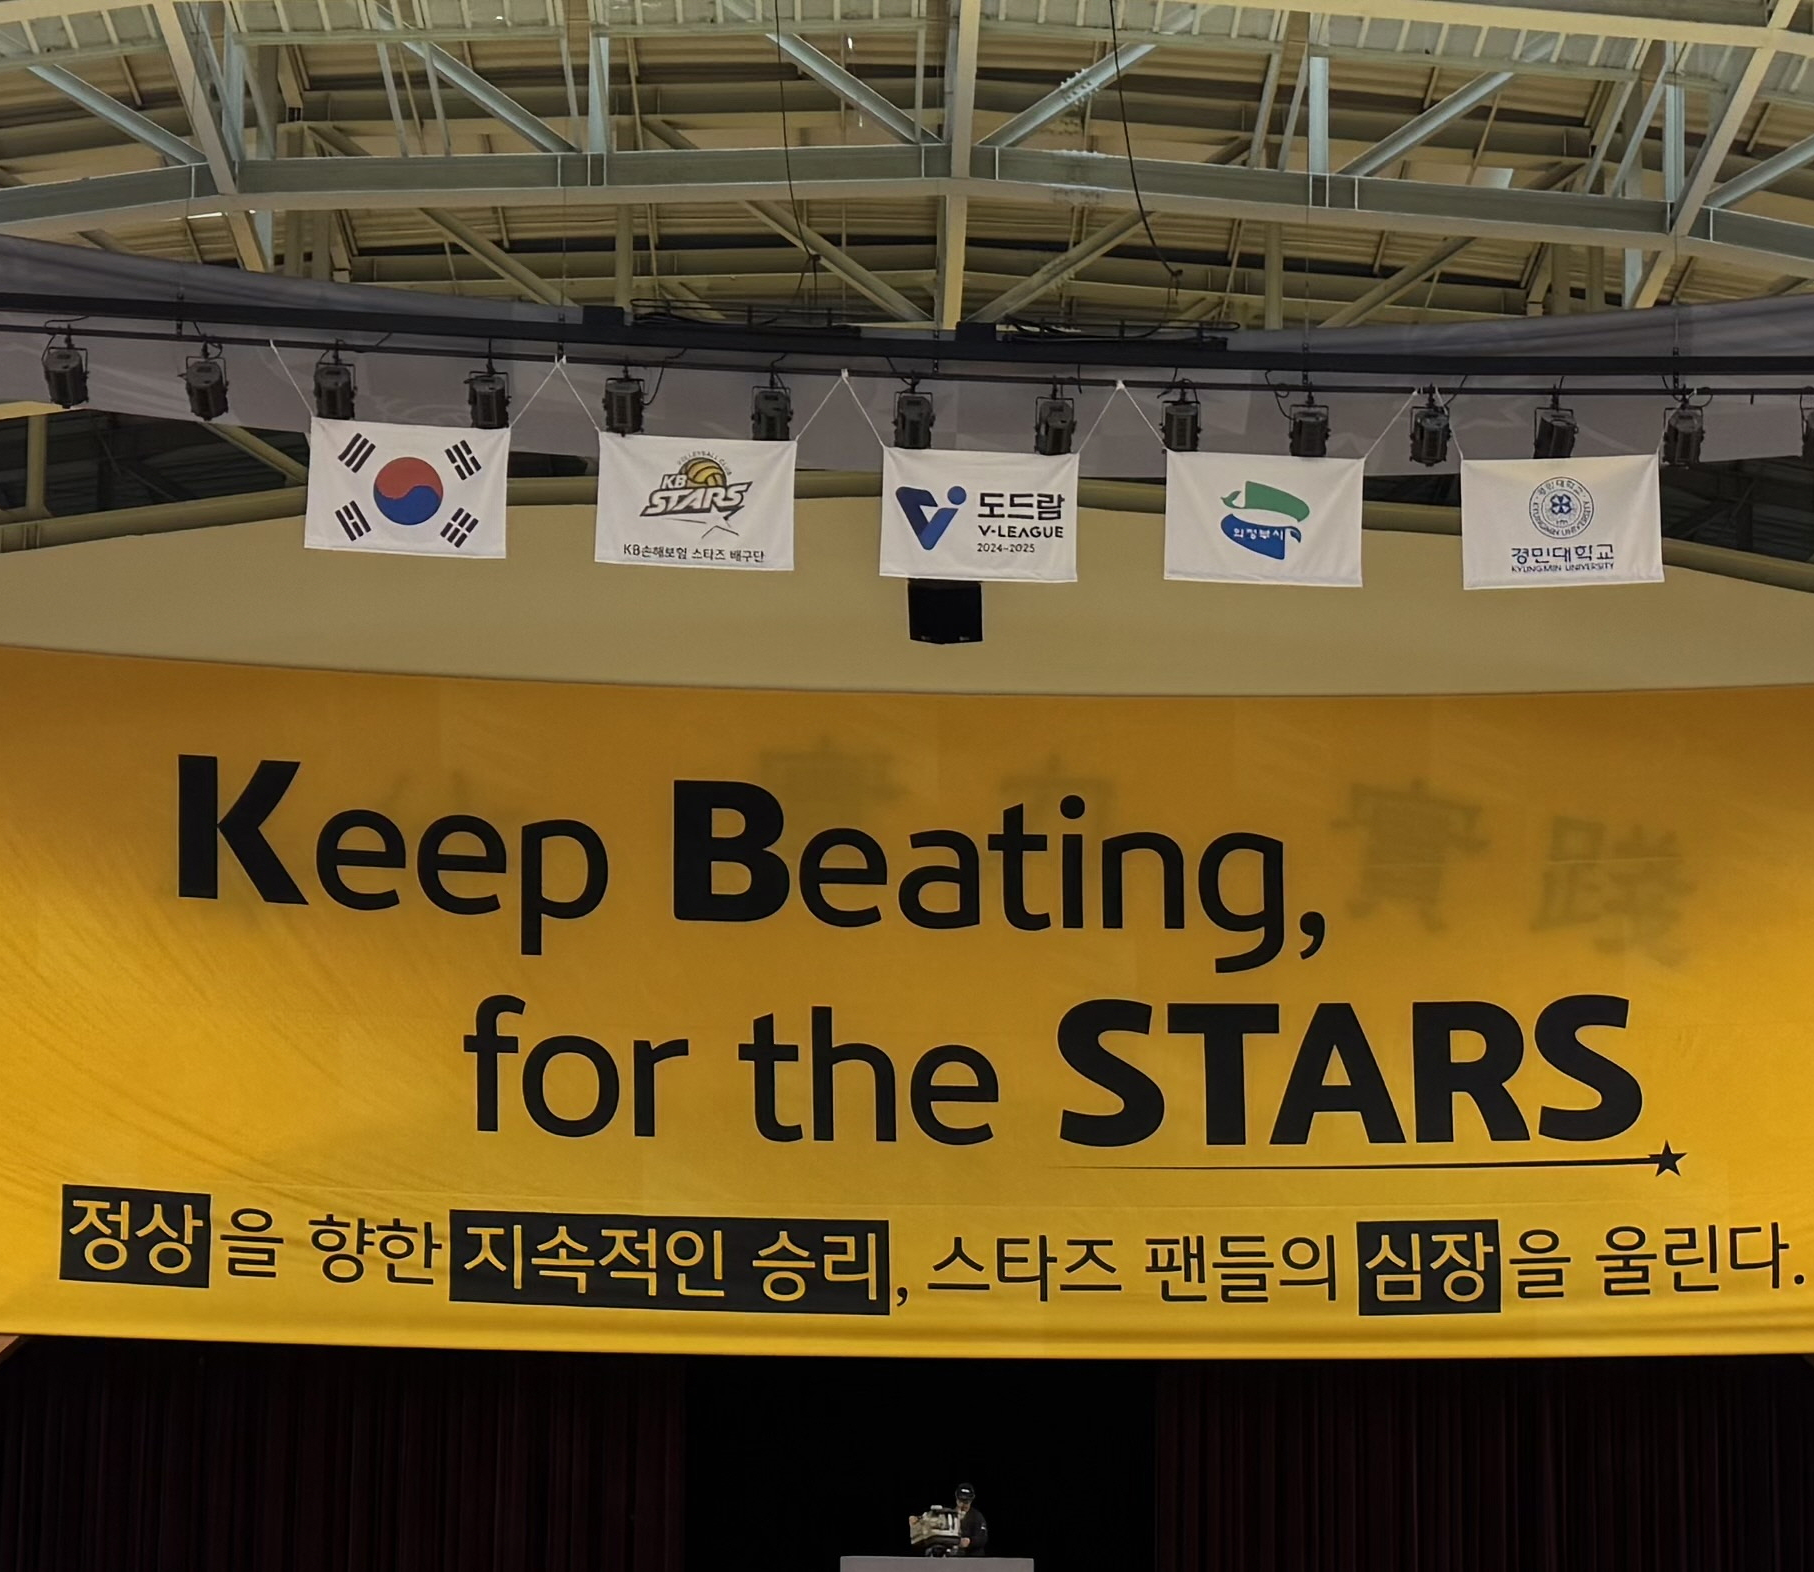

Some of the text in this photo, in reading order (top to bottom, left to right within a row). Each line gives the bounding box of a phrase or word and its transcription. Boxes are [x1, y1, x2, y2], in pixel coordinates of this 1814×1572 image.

[661, 474, 687, 489] KB
[639, 481, 753, 516] STARS
[977, 492, 1066, 521] 도드람
[978, 525, 1064, 539] V-LEAGUE
[1233, 528, 1283, 540] 의정부시
[977, 543, 1035, 553] 2024-2025
[1511, 544, 1614, 564] 경민대학교
[178, 754, 1325, 973] Keep Beating,
[463, 994, 1643, 1148] for the STARS
[68, 1197, 1806, 1306] 정상을 향한 지속적인 승리, 스타즈 팬들의 심장을 울린다.
